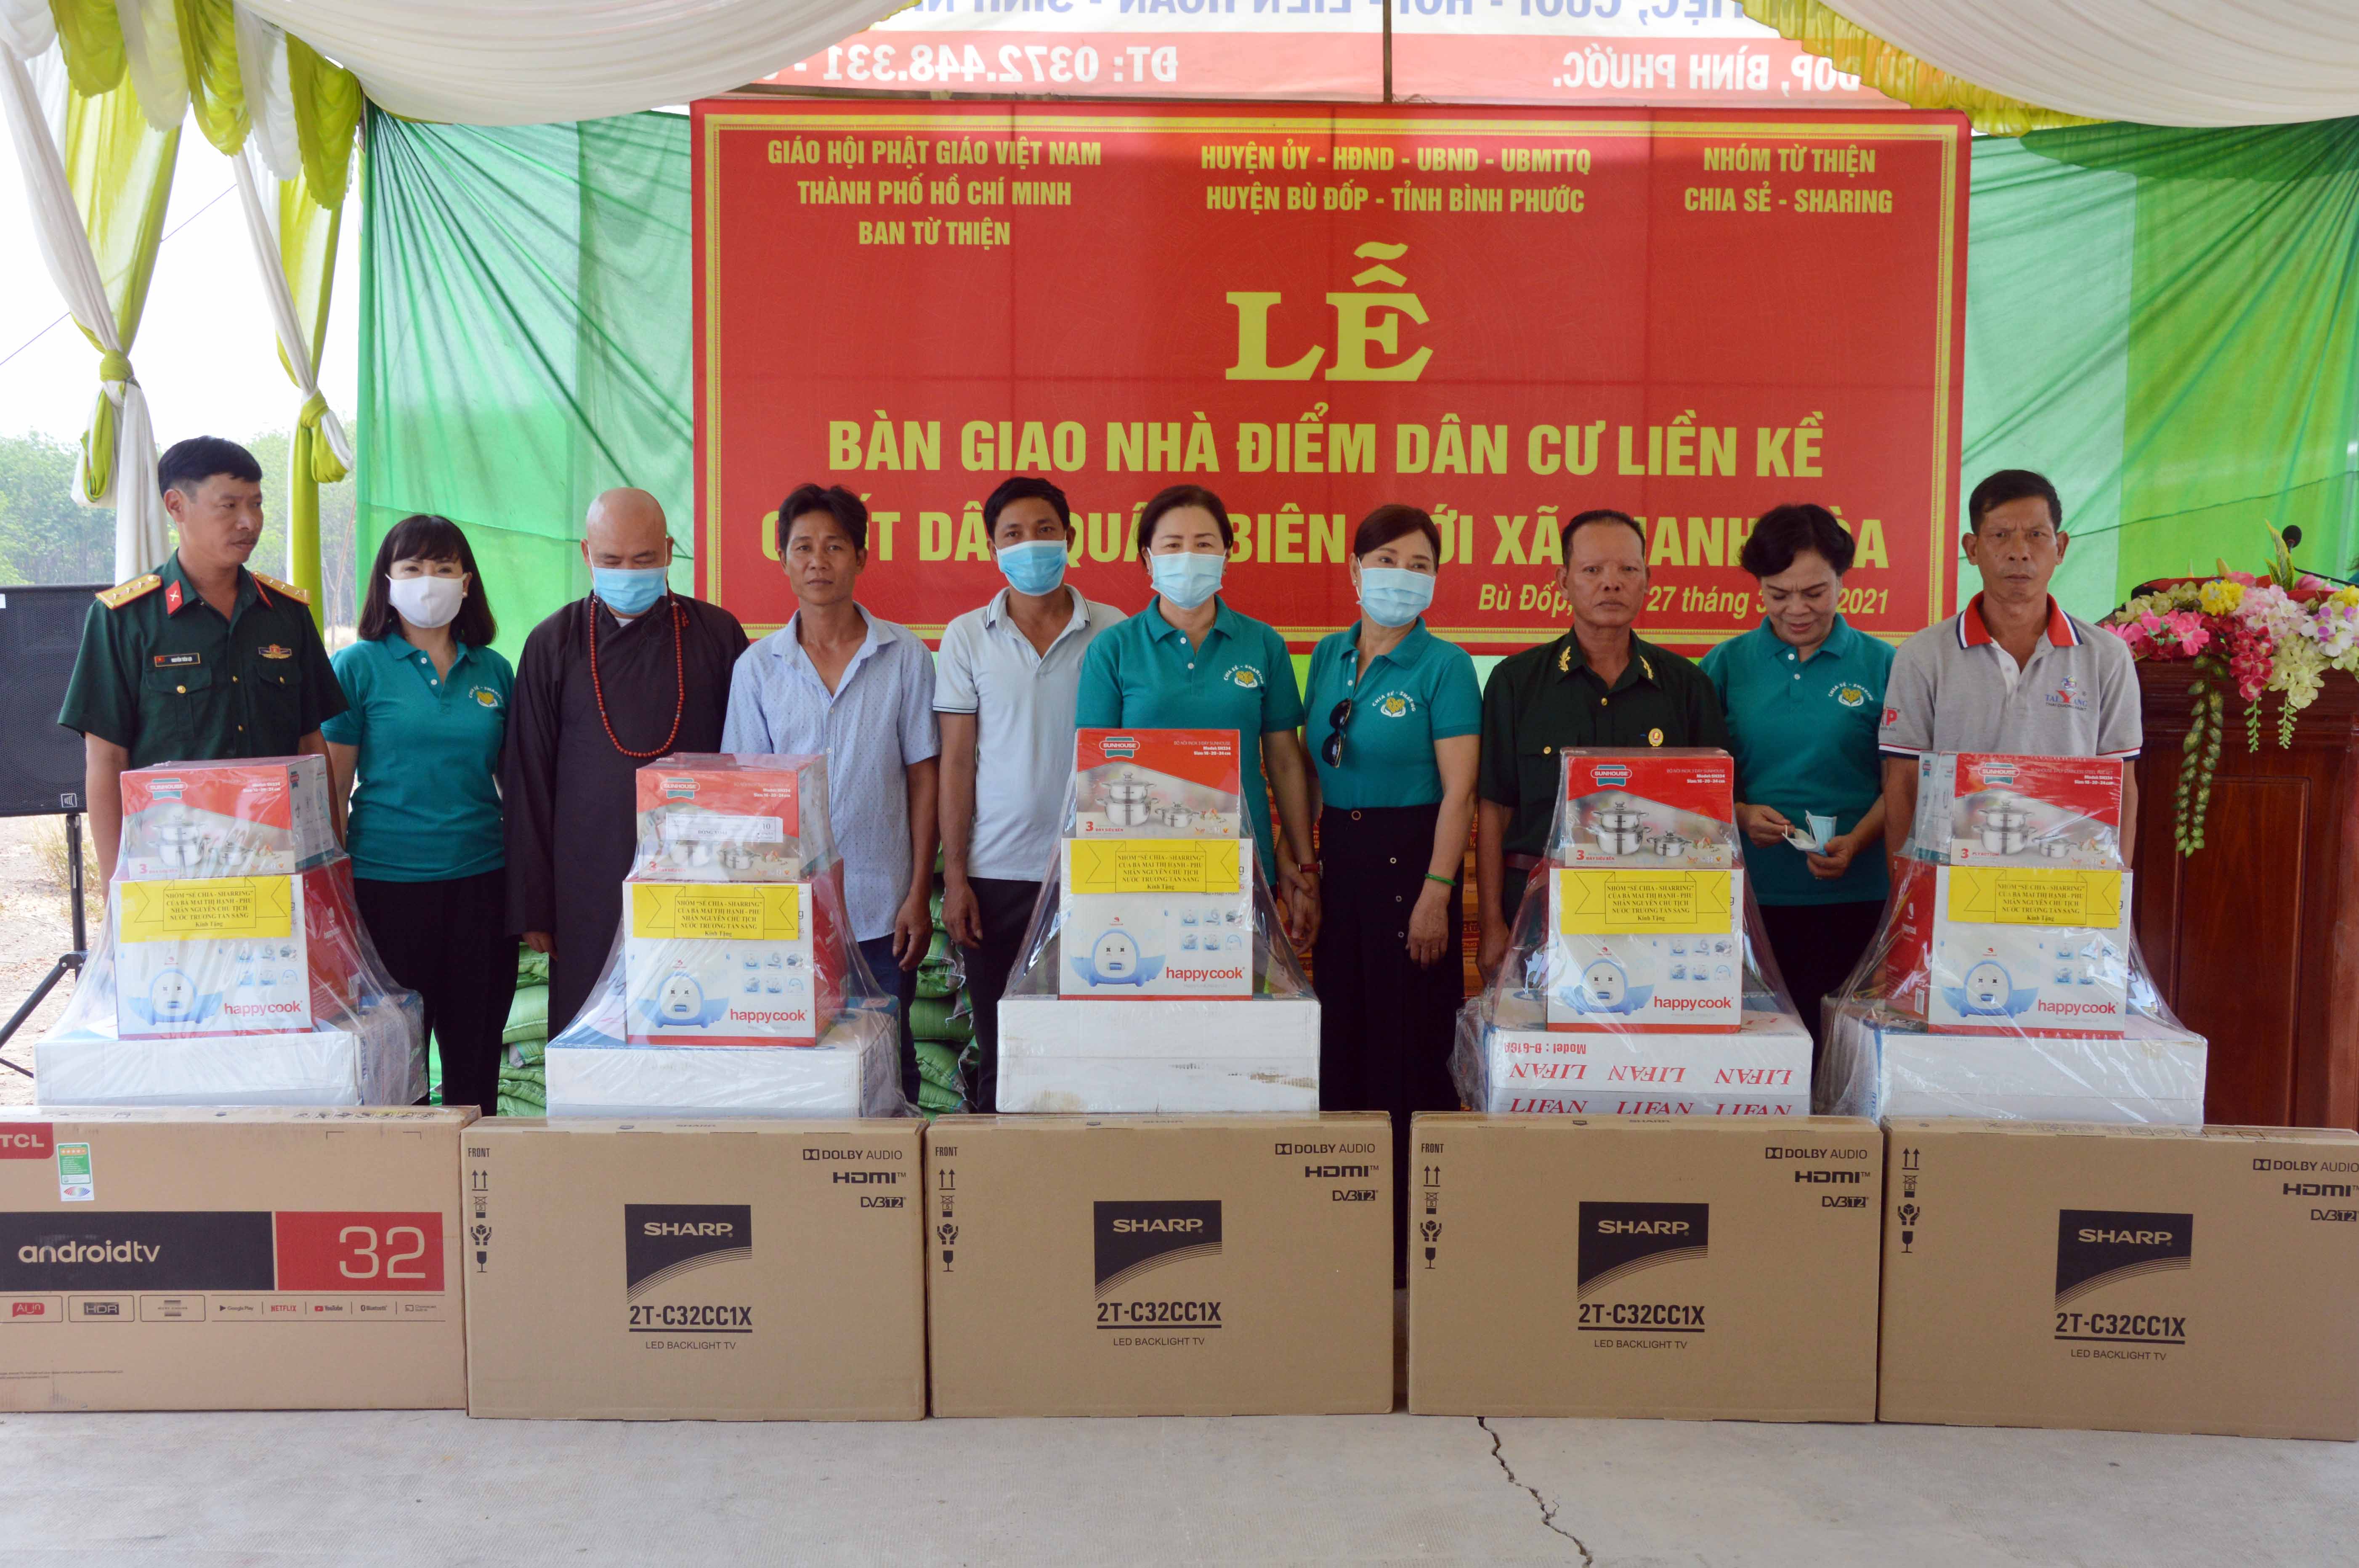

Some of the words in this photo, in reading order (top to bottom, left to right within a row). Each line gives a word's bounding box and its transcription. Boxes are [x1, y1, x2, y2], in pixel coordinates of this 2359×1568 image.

[768, 135, 820, 164] GIÁO
[827, 135, 865, 169] HỘI
[872, 135, 929, 169] PHẬT
[936, 135, 989, 164] GIÁO
[996, 137, 1042, 169] VIỆT
[1049, 141, 1101, 165] NAM
[1201, 141, 1274, 174] HUYỆN
[1283, 138, 1310, 170] ỦY
[1333, 147, 1394, 170] HĐND
[1417, 147, 1479, 172] UBND
[1501, 148, 1591, 175] UBMTTQ
[1703, 143, 1771, 171] NHÓM
[1777, 143, 1808, 172] TỪ
[1811, 144, 1876, 178] THIỆN
[797, 175, 871, 205] THÀNH
[878, 173, 924, 205] PHỐ
[930, 173, 960, 205] HỒ
[967, 176, 1004, 205] CHÍ
[1012, 182, 1071, 205] MINH
[1684, 187, 1737, 211] CHIA
[1743, 180, 1772, 212] SẺ
[1793, 188, 1893, 213] SHARING
[1206, 182, 1280, 215] HUYỆN
[1288, 183, 1316, 210] BÙ
[1323, 180, 1369, 211] ĐỐP
[1391, 180, 1442, 211] TỈNH
[1449, 183, 1503, 212] BÌNH
[1510, 184, 1585, 213] PHƯỚC
[859, 222, 905, 245] BAN
[912, 217, 941, 245] TỪ
[946, 217, 1010, 250] THIỆN
[1225, 241, 1434, 382] LỄ
[829, 409, 942, 472] BÀN
[960, 419, 1087, 474] GIAO
[1106, 411, 1219, 473] NHÀ
[1237, 401, 1376, 473] ĐIỂM
[1396, 413, 1508, 475] DÂN
[1528, 420, 1607, 476] CƯ
[1619, 409, 1736, 477] LIỀN
[1756, 411, 1824, 478] KỀ
[1492, 505, 1563, 565] XÃ
[1478, 584, 1511, 610] Bù
[1646, 587, 1672, 611] 27
[1682, 587, 1750, 619] tháng
[1836, 589, 1889, 614] 2021
[1085, 821, 1094, 832] 3
[1576, 849, 1584, 860] 3
[1165, 966, 1243, 982] happycook
[224, 1001, 303, 1017] happycook
[1653, 995, 1731, 1011] happycook
[2037, 999, 2116, 1015] happycook
[730, 1008, 806, 1024] happycook
[1552, 1043, 1586, 1054] Model
[1509, 1063, 1588, 1080] LIFAN
[1607, 1065, 1686, 1082] LIFAN
[1714, 1068, 1793, 1085] LIFAN
[1509, 1098, 1588, 1114] LIFAN
[1617, 1101, 1694, 1114] LIFAN
[0, 1133, 45, 1149] TCL
[1294, 1143, 1336, 1154] DOLBY
[1339, 1143, 1376, 1154] AUDIO
[1421, 1143, 1444, 1154] FRONT
[468, 1148, 491, 1158] FRONT
[821, 1149, 863, 1160] DOLBY
[866, 1149, 903, 1160] AUDIO
[935, 1146, 958, 1157] FRONT
[1785, 1148, 1828, 1159] DOLBY
[1830, 1148, 1868, 1159] AUDIO
[2273, 1160, 2318, 1172] DOLBY
[2320, 1160, 2359, 1172] AUDIO
[643, 1222, 734, 1236] SHARP
[1113, 1218, 1203, 1234] SHARP
[1598, 1220, 1690, 1236] SHARP
[2077, 1228, 2173, 1246] SHARP
[18, 1239, 161, 1263] androidtv
[339, 1225, 426, 1279] 32
[86, 1305, 117, 1313] HDR
[629, 1305, 752, 1326] 2T-C32CC1X
[1097, 1301, 1222, 1322] 2T-C32CC1X
[1578, 1303, 1705, 1326] 2T-C32CC1X
[2055, 1313, 2185, 1338] 2T-C32CC1X
[646, 1340, 664, 1350] LED
[667, 1340, 723, 1350] BACKLIGHT
[723, 1340, 736, 1350] TV
[1113, 1337, 1132, 1346] LED
[1135, 1337, 1190, 1346] BACKLIGHT
[1191, 1337, 1205, 1346] TV
[1594, 1339, 1613, 1348] LED
[1616, 1339, 1672, 1348] BACKLIGHT
[1674, 1339, 1687, 1348] TV
[2071, 1348, 2091, 1360] LED
[2093, 1348, 2151, 1360] BACKLIGHT
[2153, 1348, 2167, 1360] TV
